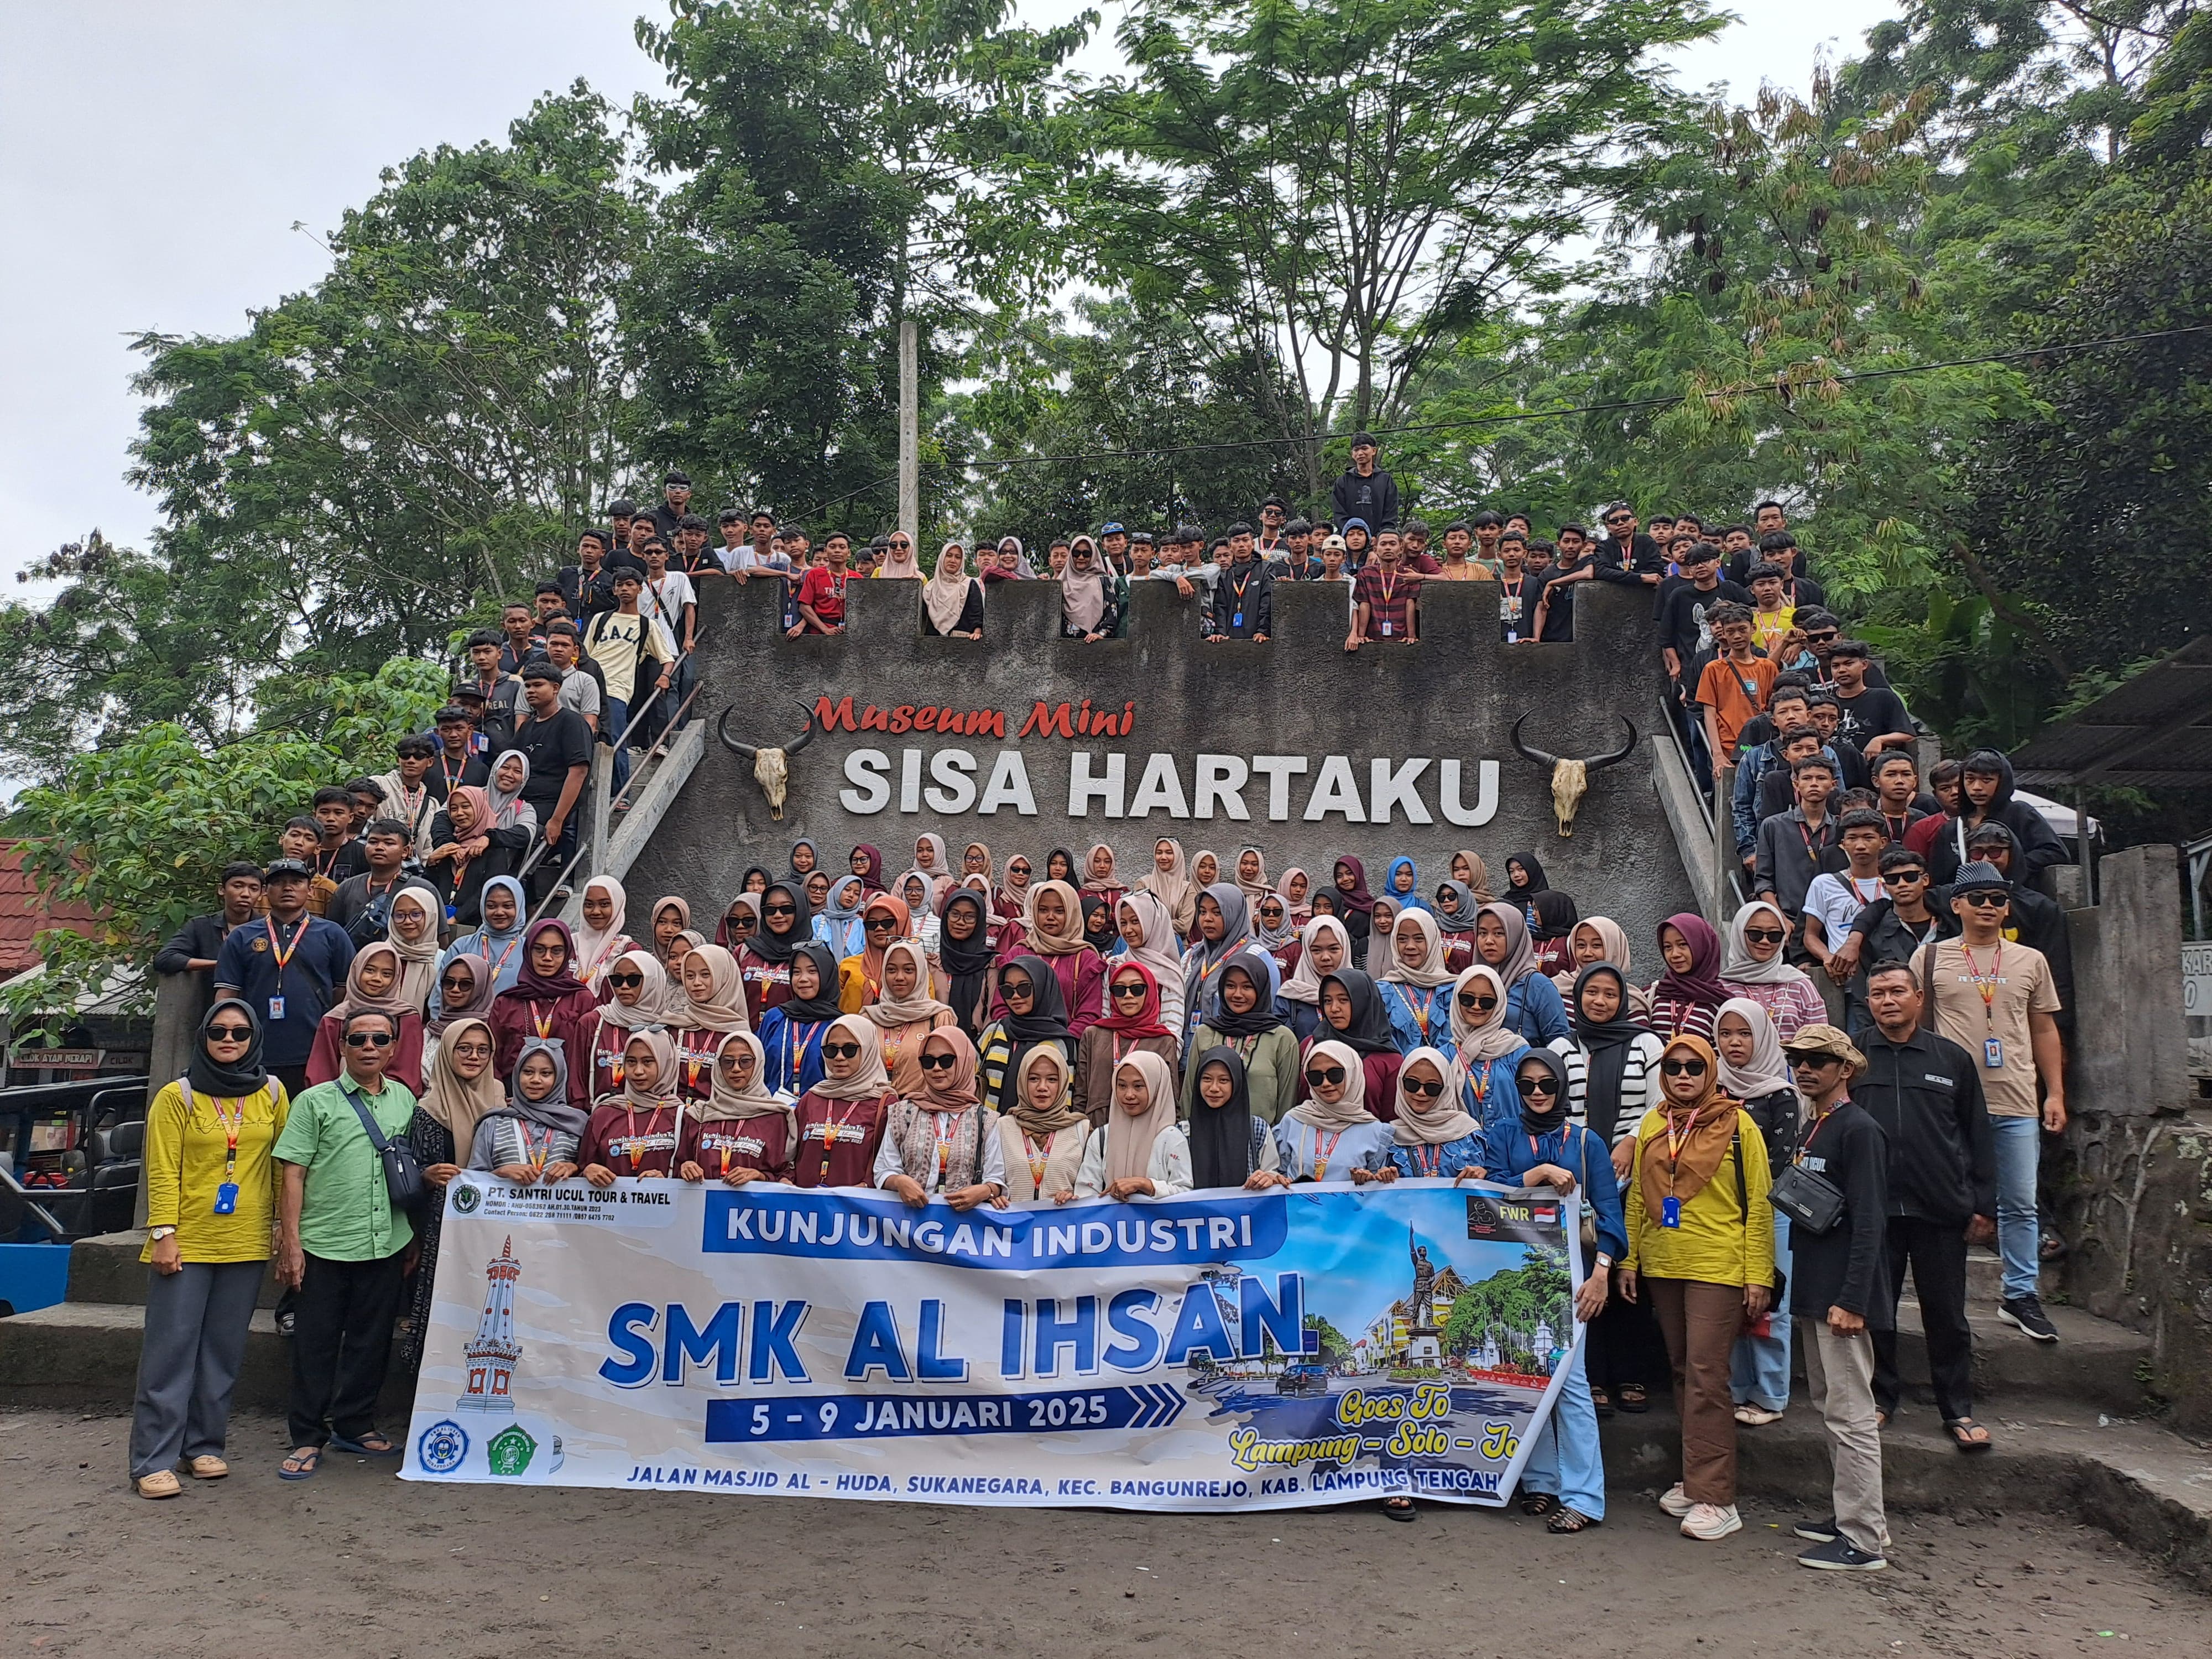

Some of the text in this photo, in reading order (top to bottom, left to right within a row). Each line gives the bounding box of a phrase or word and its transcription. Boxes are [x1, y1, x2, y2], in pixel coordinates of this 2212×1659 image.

[803, 696, 1134, 738] Museum Mini
[839, 749, 1499, 827] SISA HARTAKU
[488, 1187, 671, 1205] PT. SANTRI UCUL TOUR & TRAVEL
[1499, 1206, 1530, 1222] FWR
[726, 1207, 1253, 1258] KUNJUNGAN INDUSTRI
[598, 1300, 812, 1389] SMK
[843, 1299, 969, 1383] AL
[750, 1396, 1107, 1434] 5 - 9 JANUARI 2025
[1339, 1384, 1450, 1425] Goes To
[1230, 1429, 1360, 1472] Lampung
[1388, 1421, 1449, 1458] Solo
[627, 1466, 697, 1485] JALAN
[704, 1469, 779, 1488] MASJID
[786, 1472, 811, 1490] AL
[836, 1474, 898, 1495] HUDA,
[907, 1475, 1050, 1498] SUKANEGARA,
[1057, 1479, 1102, 1495] KEC.
[1110, 1480, 1253, 1499] BANGUNREJO,
[1261, 1478, 1305, 1495] KAB.
[1313, 1470, 1408, 1491] LAMPUNG
[1417, 1469, 1499, 1491] TENGAH
